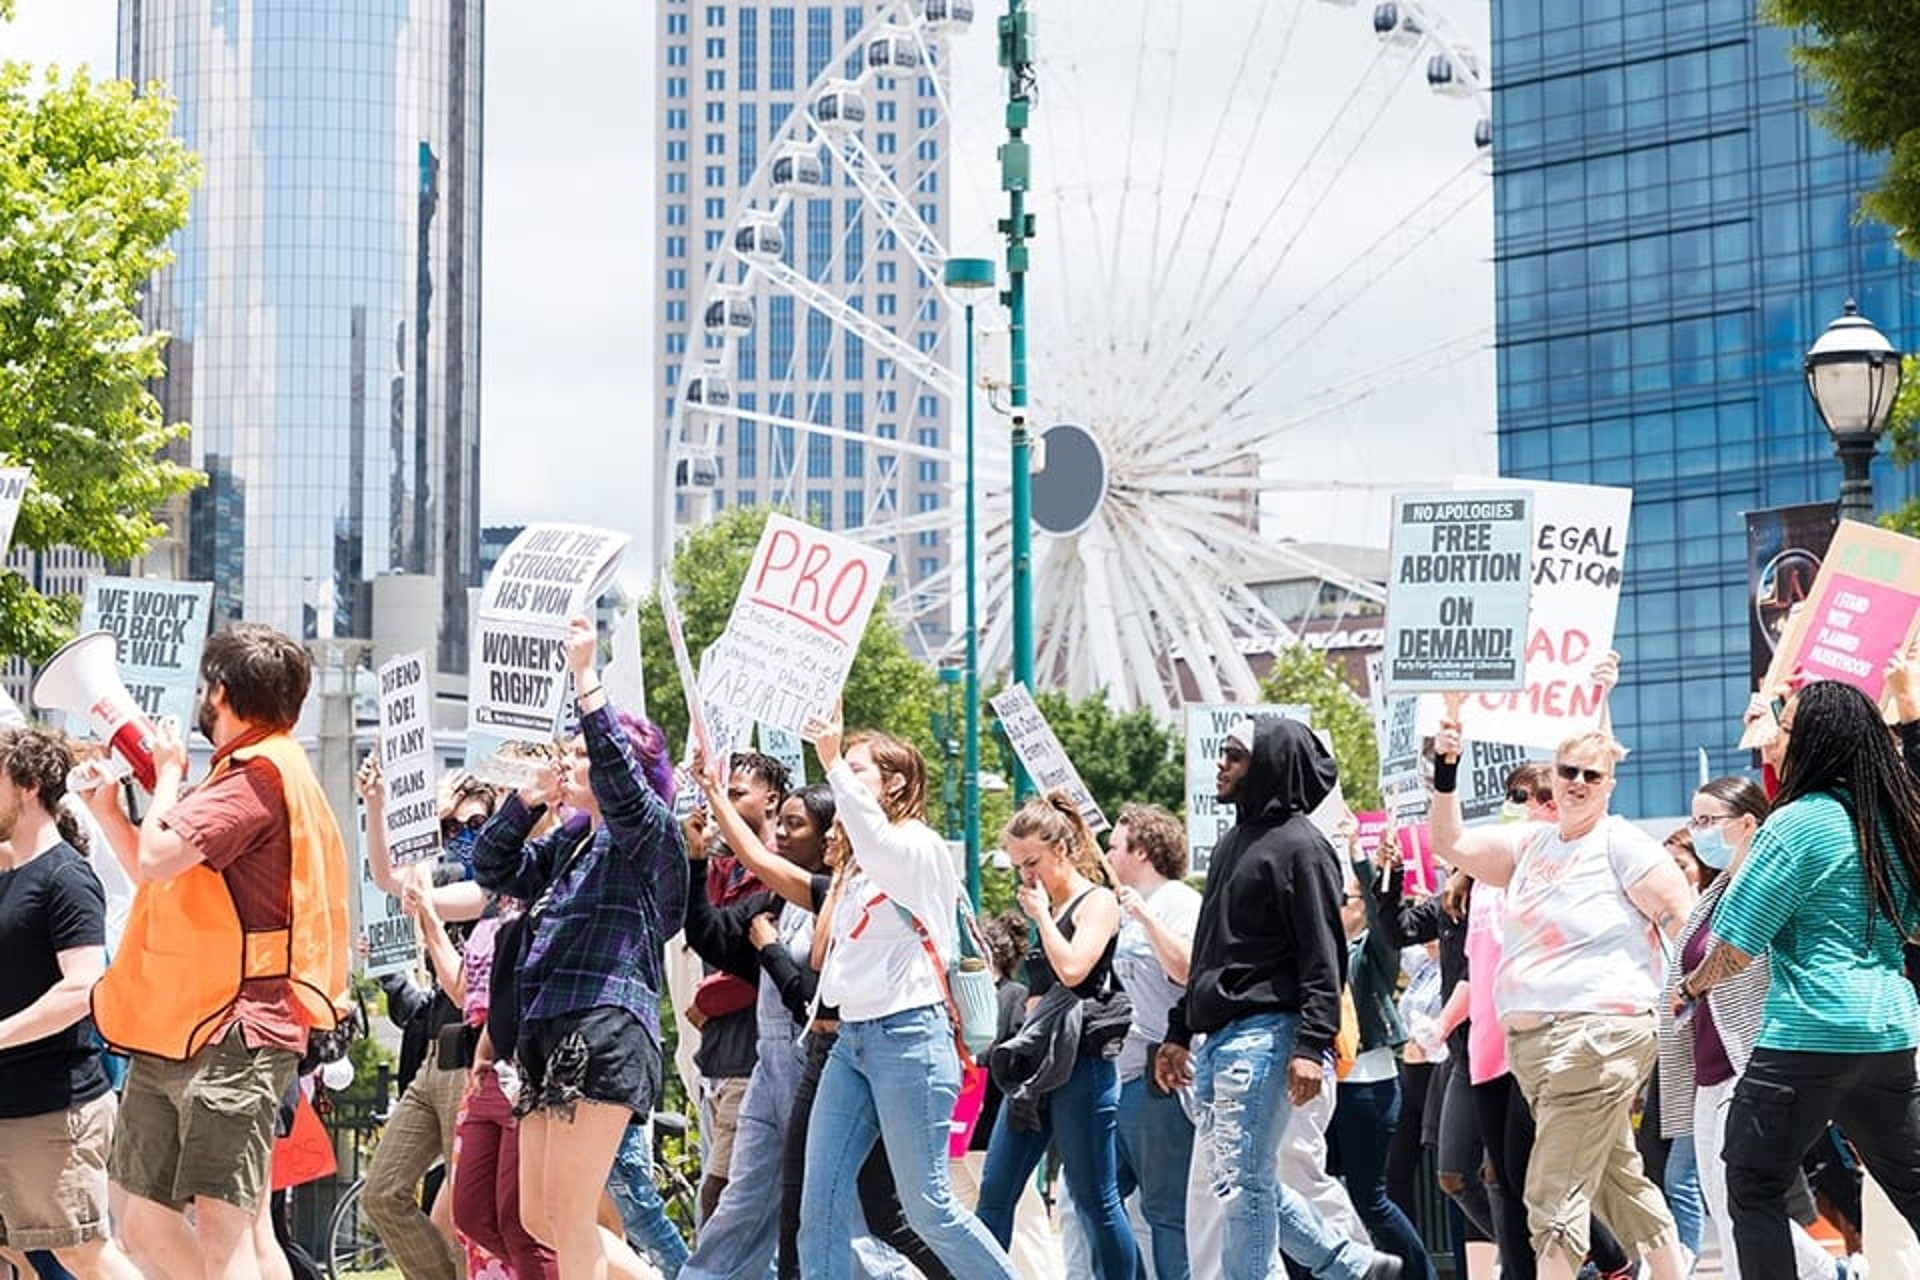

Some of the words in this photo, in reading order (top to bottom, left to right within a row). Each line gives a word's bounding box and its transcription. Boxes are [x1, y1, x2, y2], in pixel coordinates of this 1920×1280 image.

[1413, 506, 1432, 521] NO
[1435, 503, 1514, 520] APOLOGIES
[524, 528, 572, 552] ONLY
[571, 532, 611, 557] THE
[1432, 524, 1491, 553] FREE
[1537, 525, 1619, 557] EGAL
[503, 552, 594, 583] STRUGGLE
[756, 529, 868, 626] PRO
[1400, 553, 1521, 584] ABORTION
[97, 589, 129, 613] WE
[132, 591, 199, 620] WON'T
[494, 581, 531, 611] HAS
[530, 585, 573, 616] WON
[1439, 596, 1474, 627] ON
[99, 614, 127, 639] GO
[130, 617, 188, 645] BACK
[1399, 628, 1513, 659] DEMAND!
[131, 641, 182, 669] WILL
[482, 631, 568, 673] WOMEN'S
[1525, 628, 1591, 666] AD
[490, 670, 553, 709] RIGHTS
[399, 726, 425, 754] ANY
